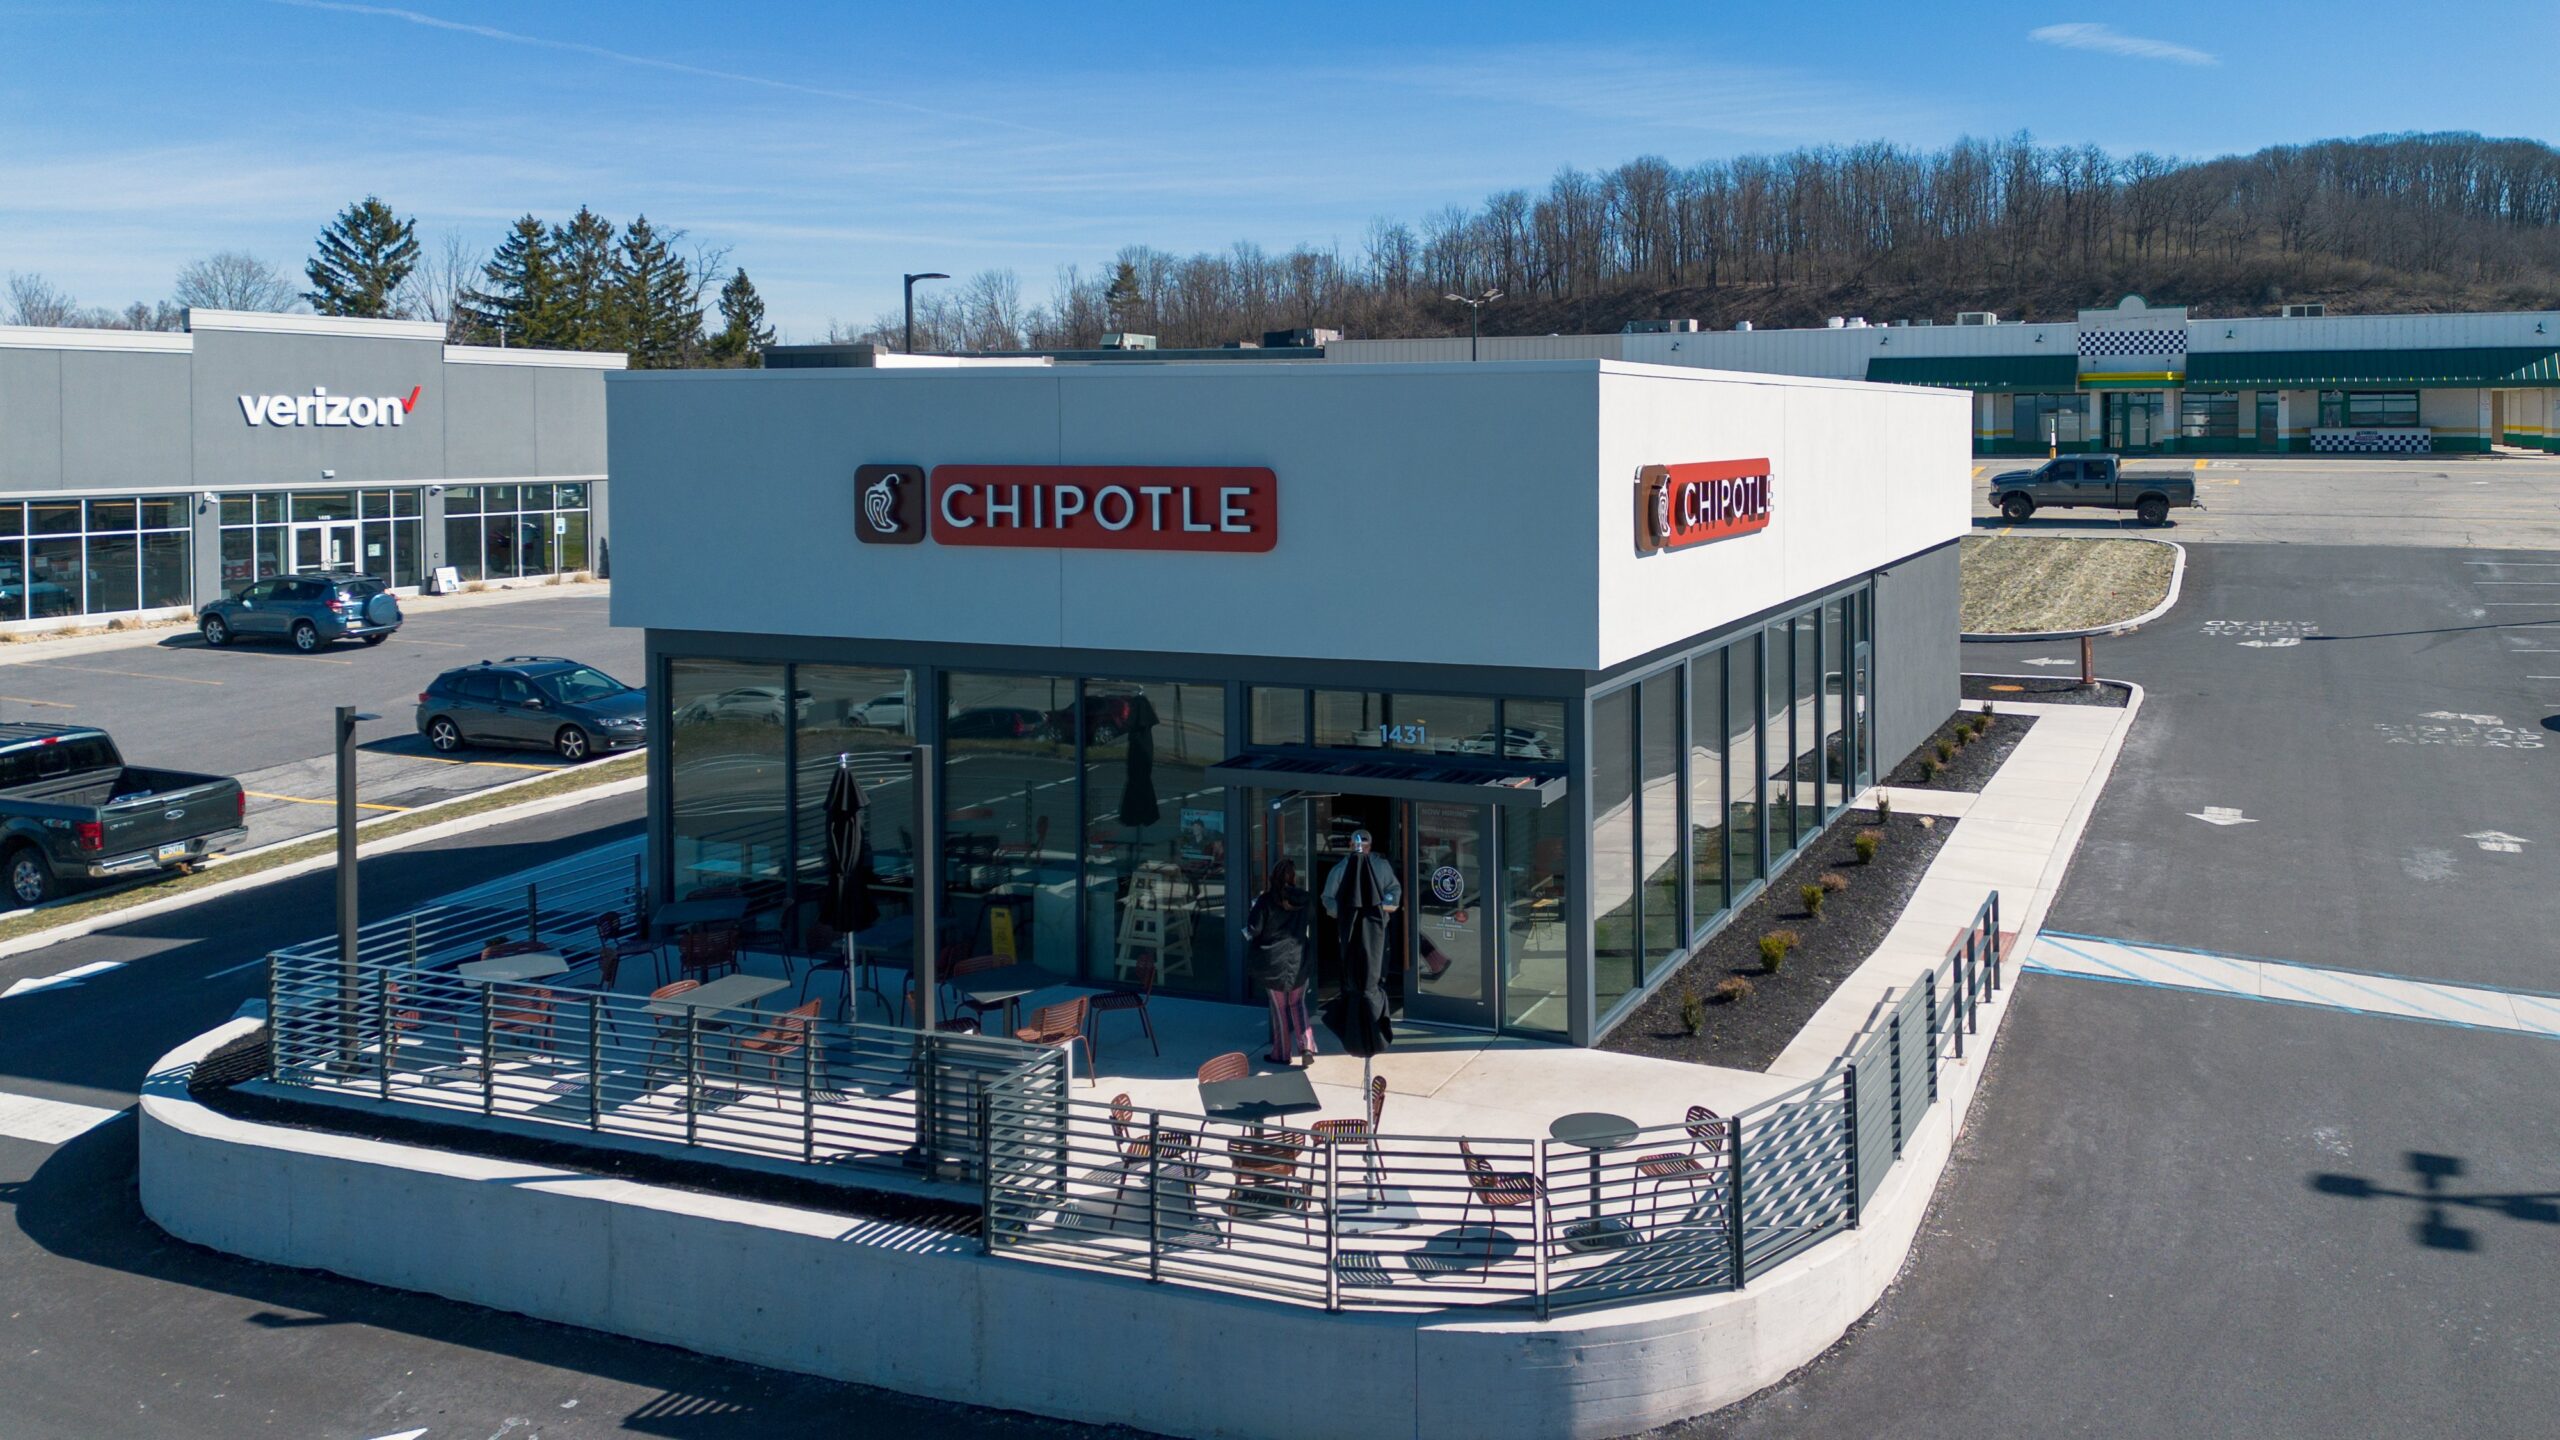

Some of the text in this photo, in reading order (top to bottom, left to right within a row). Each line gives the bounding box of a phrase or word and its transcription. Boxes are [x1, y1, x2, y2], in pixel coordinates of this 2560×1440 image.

[239, 386, 403, 427] verizon
[941, 484, 1251, 532] CHIPOTLE
[1684, 474, 1774, 526] CHIPOTLE
[1380, 724, 1425, 744] 1431
[2385, 737, 2545, 749] AHEAD
